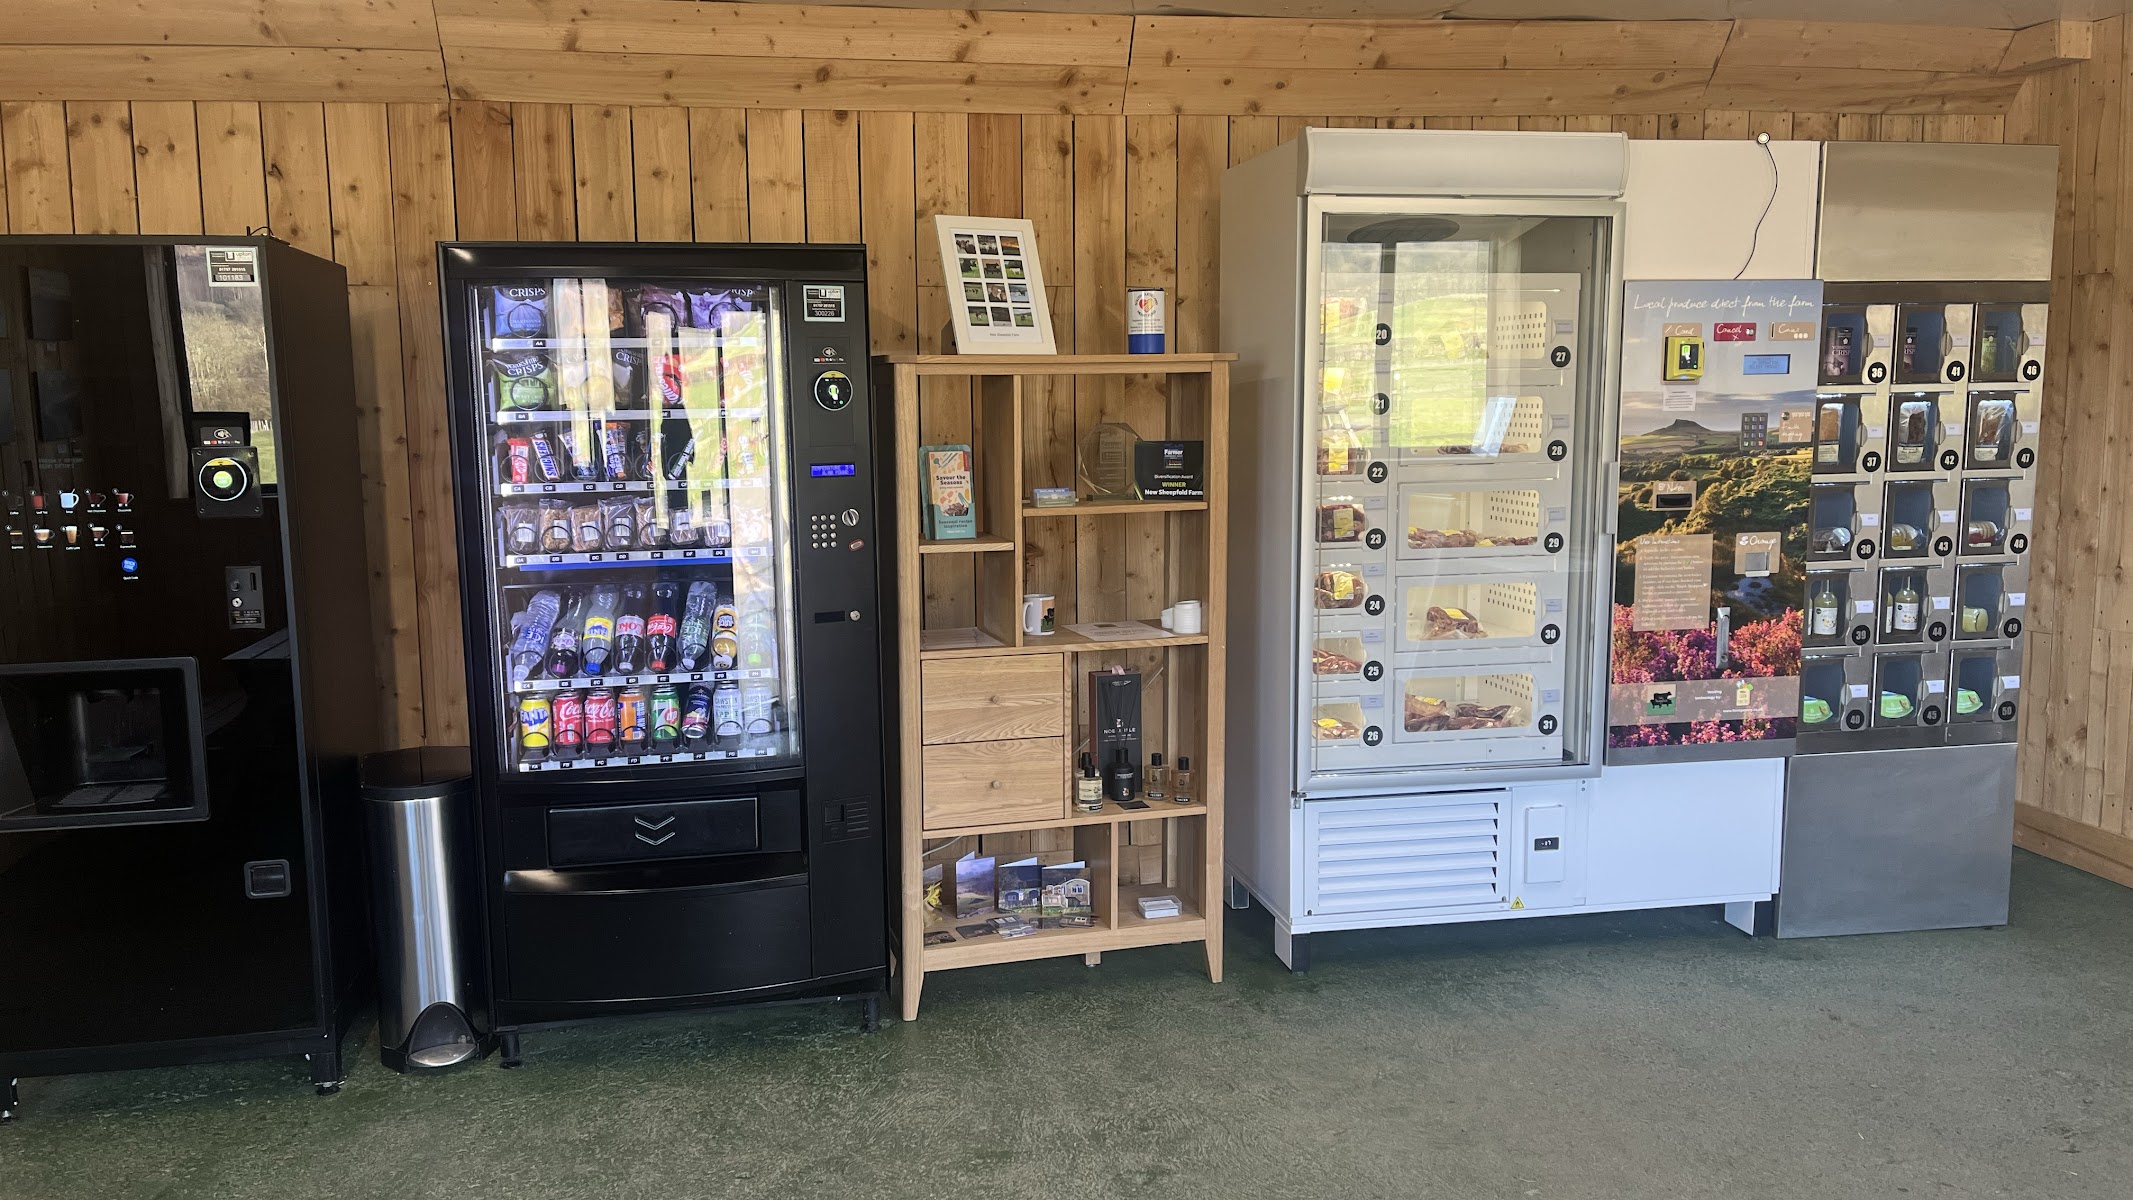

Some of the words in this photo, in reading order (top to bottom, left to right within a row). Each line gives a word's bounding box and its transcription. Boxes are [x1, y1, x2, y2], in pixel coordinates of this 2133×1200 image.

[509, 288, 546, 297] CRISPS
[1634, 295, 1665, 310] Local
[1666, 297, 1708, 318] produce
[1711, 299, 1738, 309] direct
[1742, 296, 1765, 317] from
[1769, 295, 1786, 307] the
[1788, 295, 1814, 317] farm
[1675, 326, 1694, 336] Card
[1716, 324, 1742, 334] Cancel
[1376, 329, 1387, 340] 20
[1556, 352, 1565, 362] 27
[508, 363, 543, 376] CRISPS
[1872, 368, 1882, 378] 36
[1952, 367, 1960, 377] 41
[2027, 366, 2037, 376] 46
[1374, 399, 1385, 410] 21
[1552, 446, 1562, 456] 28
[535, 441, 556, 477] SNICKERS
[1867, 457, 1876, 467] 37
[1945, 456, 1954, 465] 42
[2021, 454, 2030, 463] 47
[1372, 468, 1383, 478] 22
[1371, 534, 1381, 545] 23
[1549, 538, 1559, 548] 29
[2014, 539, 2024, 549] 48
[1861, 545, 1871, 555] 38
[1939, 542, 1948, 551] 43
[1370, 601, 1380, 611] 24
[617, 622, 643, 635] Coke
[1933, 627, 1942, 637] 44
[2008, 624, 2017, 633] 49
[1545, 630, 1556, 640] 30
[1856, 630, 1866, 641] 39
[1368, 667, 1379, 676] 25
[1927, 711, 1936, 720] 45
[2002, 706, 2011, 716] 50
[1543, 720, 1552, 730] 31
[1850, 715, 1860, 725] 40
[1368, 731, 1378, 741] 26
